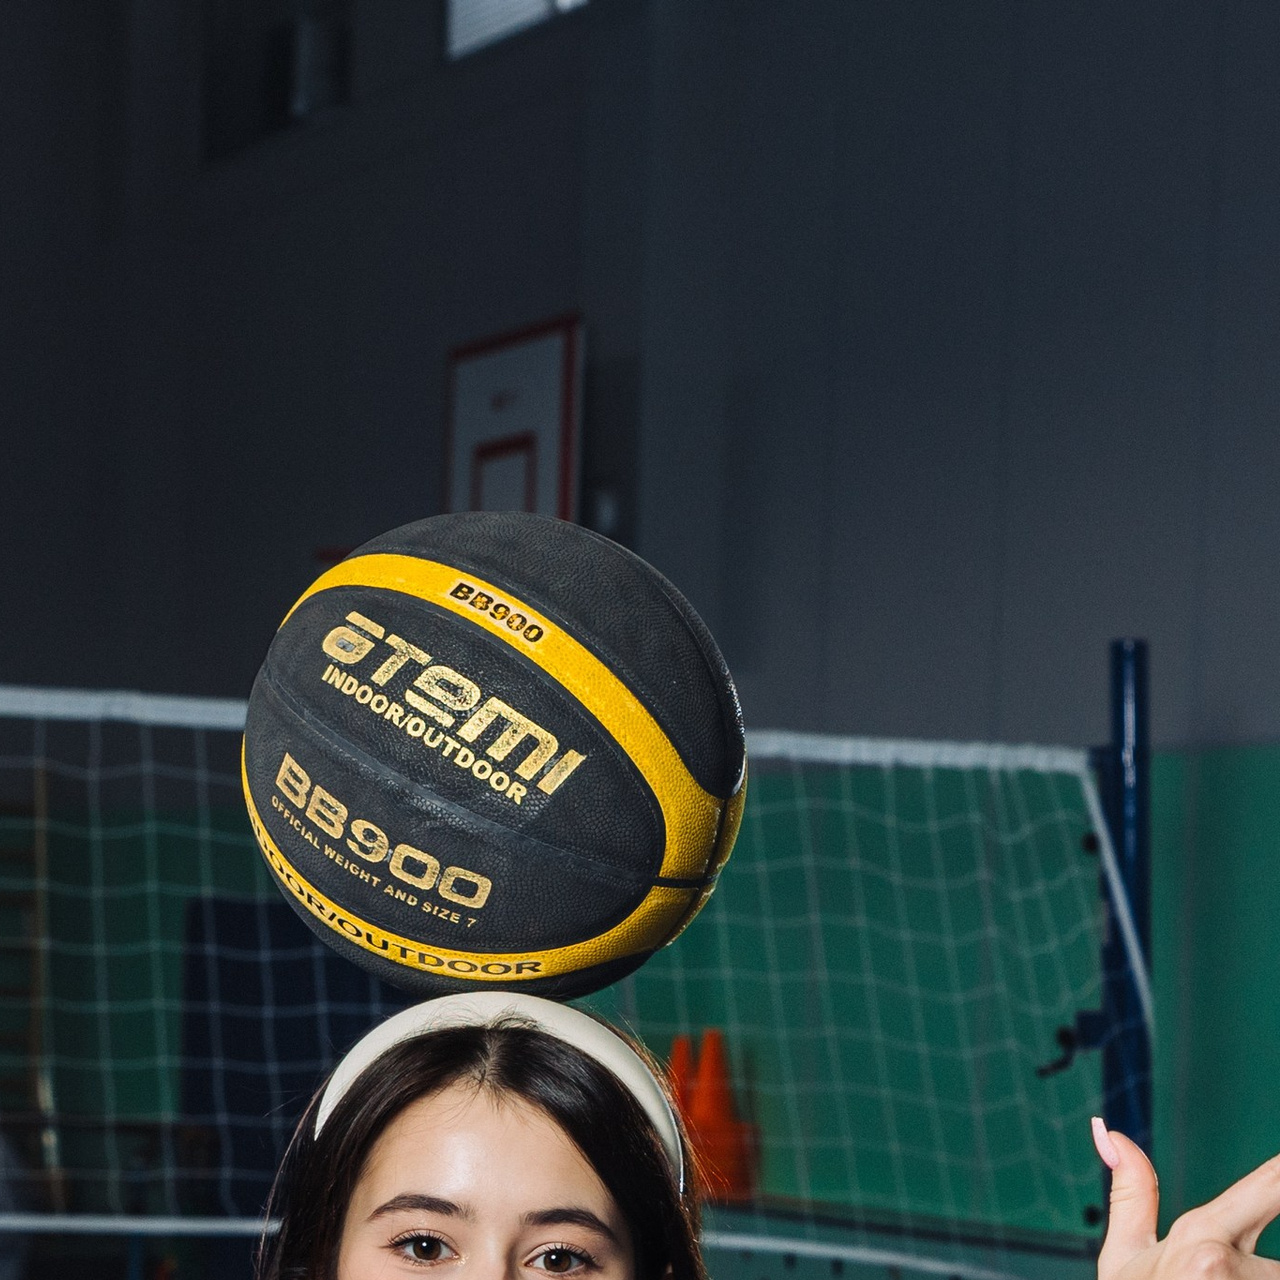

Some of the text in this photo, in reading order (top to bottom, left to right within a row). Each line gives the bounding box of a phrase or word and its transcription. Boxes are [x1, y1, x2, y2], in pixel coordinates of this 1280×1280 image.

[449, 582, 544, 643] BB900
[321, 664, 528, 806] INDOOR/OUTDOOR
[271, 795, 478, 928] OFFICIAL WEIGHT AND SIZE 7
[275, 751, 493, 909] BB900
